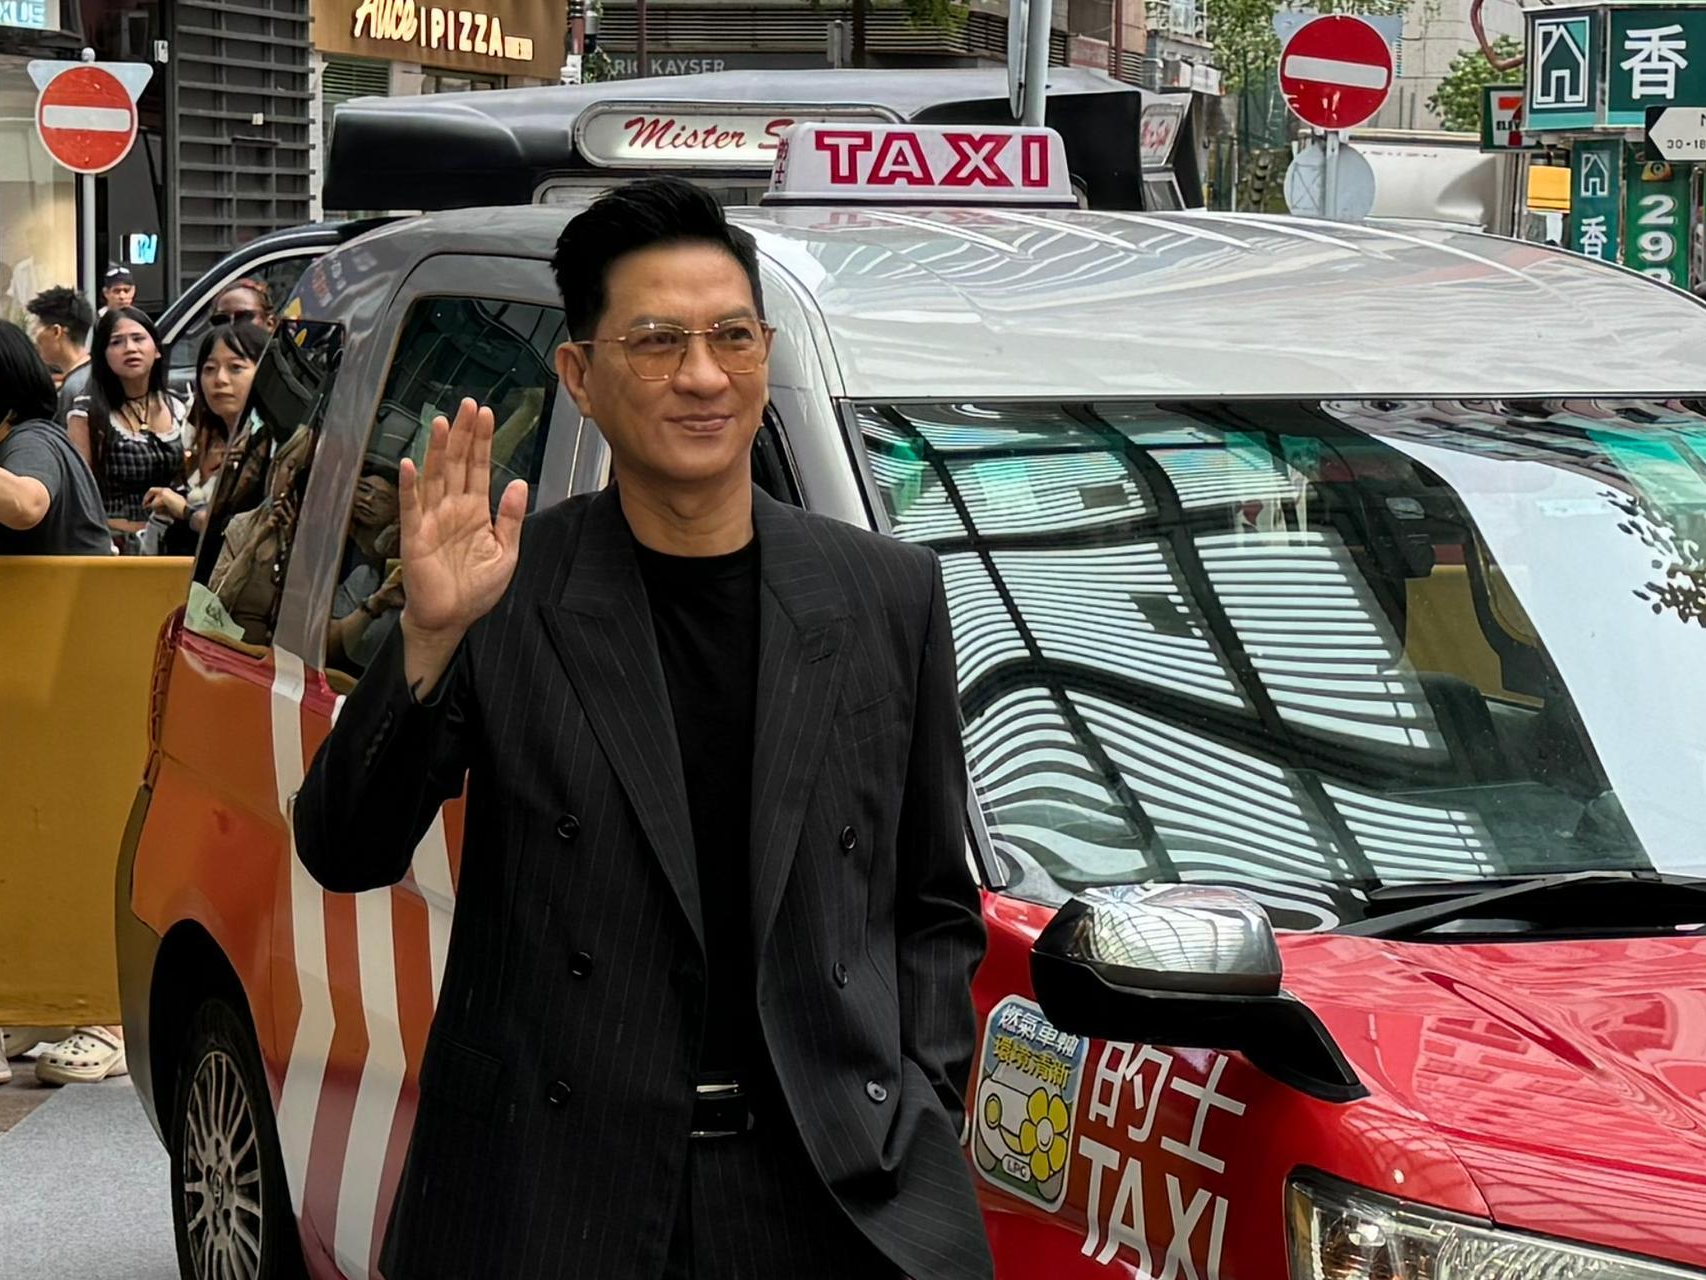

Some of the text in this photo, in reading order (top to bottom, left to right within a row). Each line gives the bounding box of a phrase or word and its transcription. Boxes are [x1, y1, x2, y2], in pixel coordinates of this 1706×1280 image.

[430, 7, 504, 58] PIZZA
[651, 59, 725, 74] KAYSER
[624, 117, 747, 150] Mister
[815, 130, 1050, 188] TAXI
[1088, 1040, 1246, 1175] 的士
[1007, 1159, 1028, 1179] LPG
